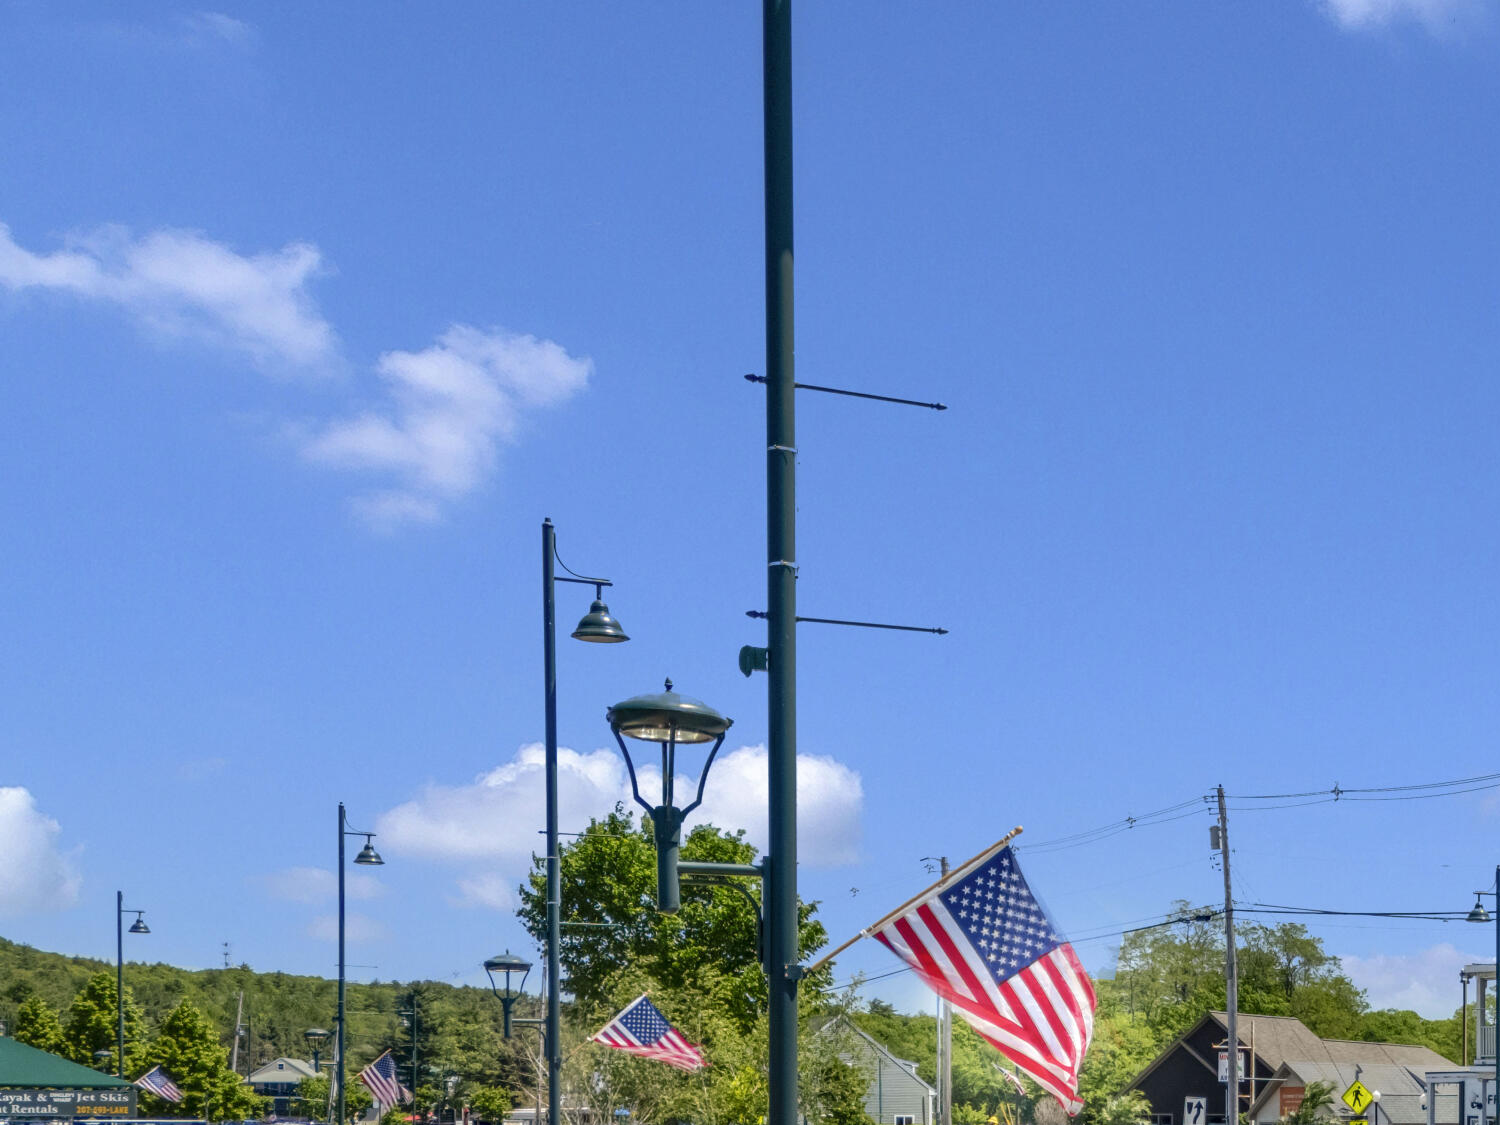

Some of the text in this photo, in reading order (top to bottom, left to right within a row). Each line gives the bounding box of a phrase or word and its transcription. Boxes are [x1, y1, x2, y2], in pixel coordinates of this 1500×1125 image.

[37, 1093, 47, 1102] &
[76, 1093, 95, 1102] Jet
[100, 1093, 129, 1102] Skis
[11, 1104, 58, 1114] Rentals
